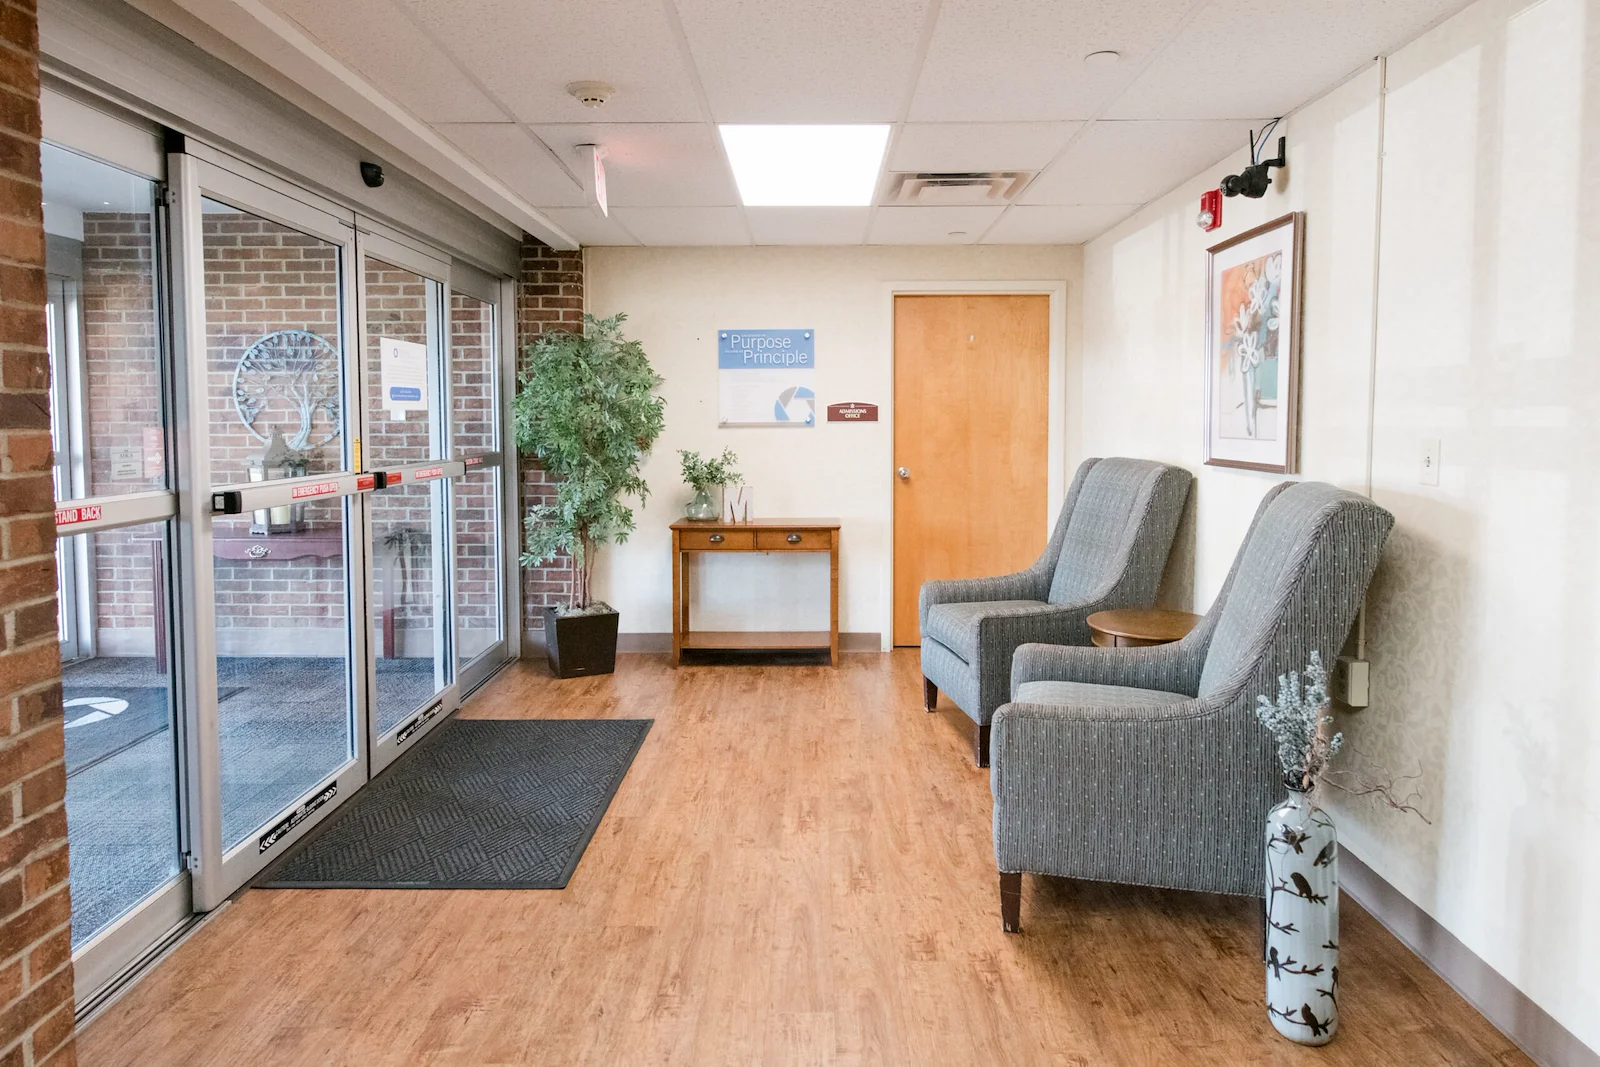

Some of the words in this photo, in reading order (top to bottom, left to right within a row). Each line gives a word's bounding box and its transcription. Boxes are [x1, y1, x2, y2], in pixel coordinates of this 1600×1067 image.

[731, 334, 791, 351] Purpose
[743, 349, 808, 366] Principle
[81, 506, 101, 520] BACK
